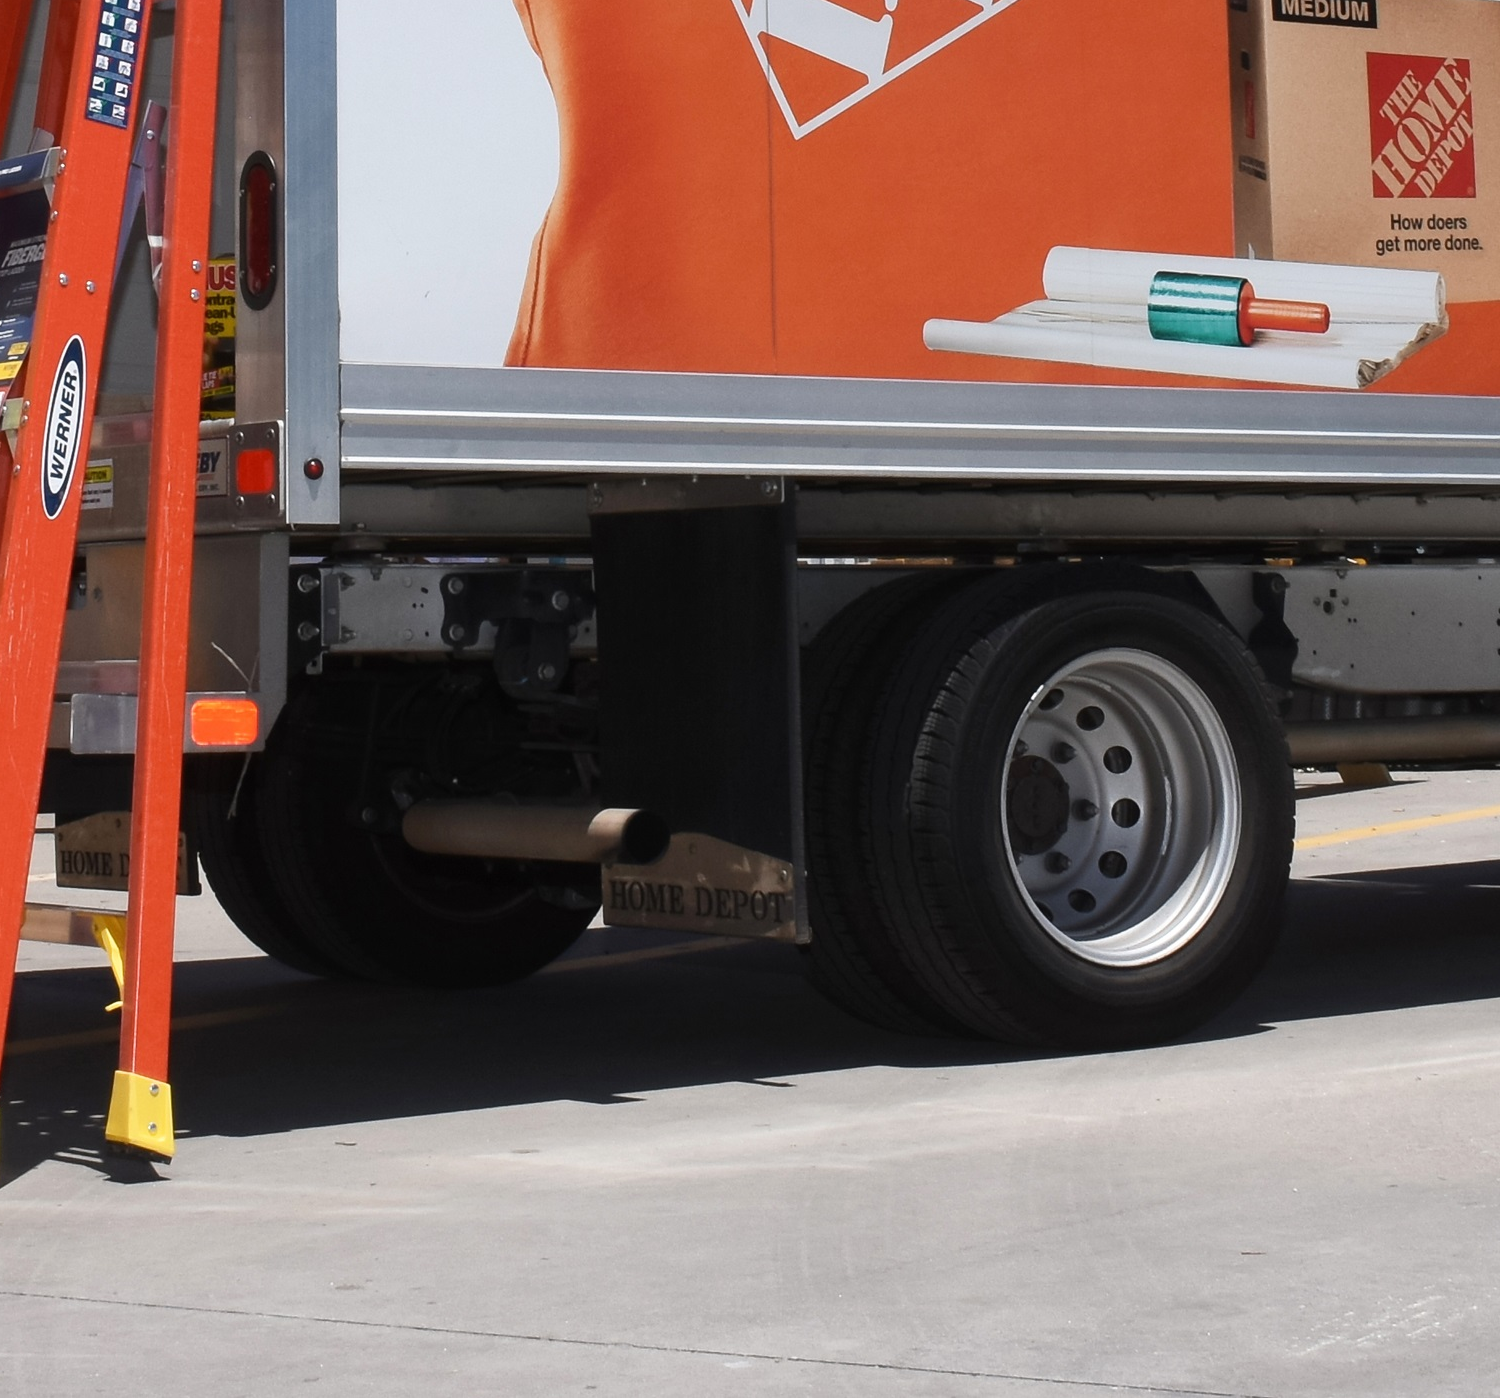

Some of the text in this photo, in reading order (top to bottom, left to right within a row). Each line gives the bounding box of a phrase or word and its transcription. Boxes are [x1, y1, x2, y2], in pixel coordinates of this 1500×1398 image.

[1379, 69, 1423, 126] THE
[1371, 58, 1472, 198] HOME
[1414, 110, 1473, 198] DEPOT
[1390, 213, 1467, 230] How doers
[1, 243, 45, 268] FIBERG
[1376, 233, 1483, 255] get more done.
[207, 265, 235, 291] US
[50, 371, 77, 479] WERNER
[61, 850, 113, 877] HOME
[610, 880, 786, 923] HOME DEPOT
